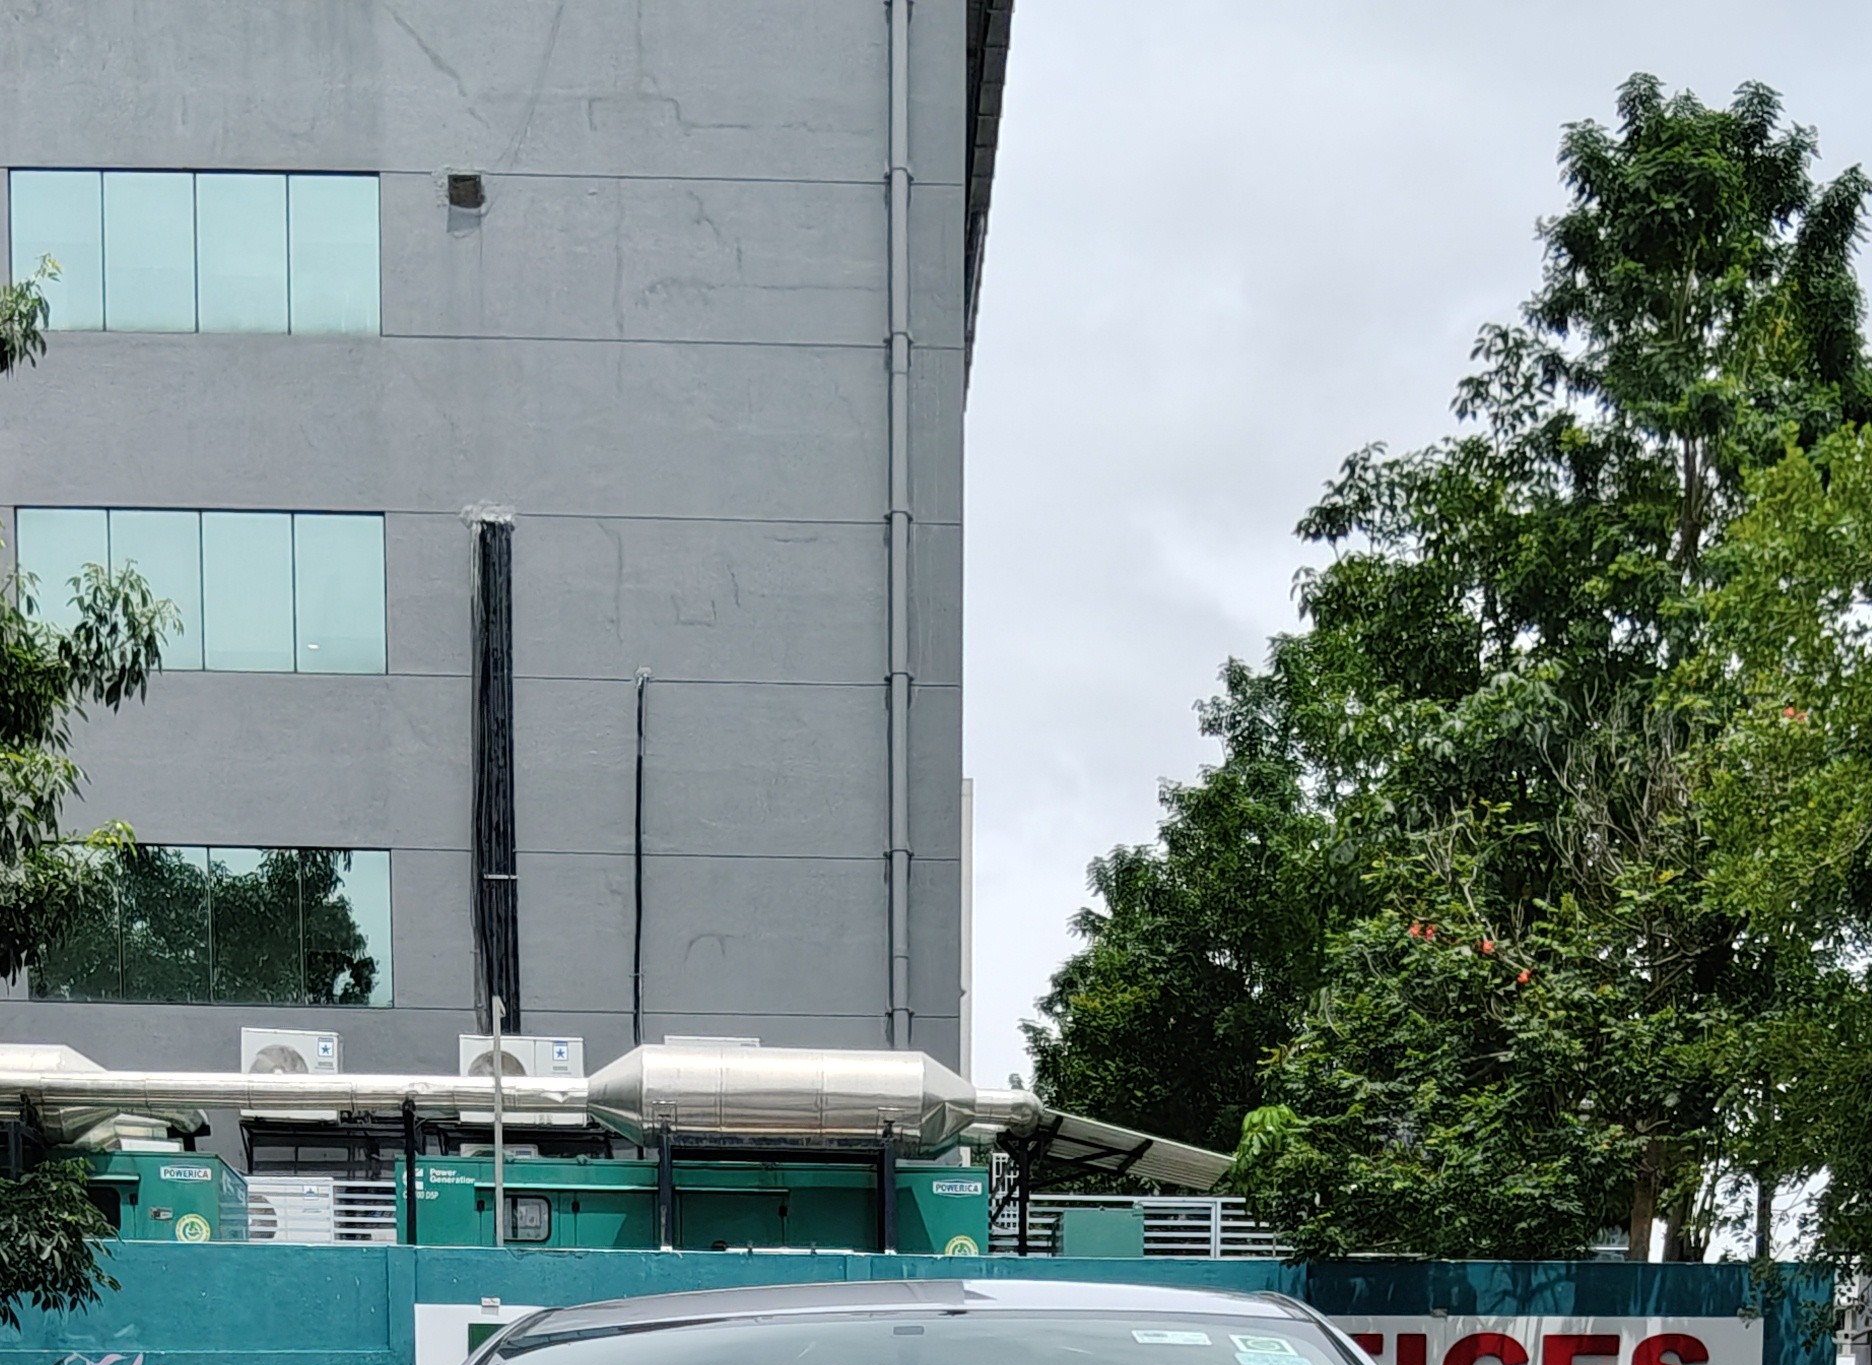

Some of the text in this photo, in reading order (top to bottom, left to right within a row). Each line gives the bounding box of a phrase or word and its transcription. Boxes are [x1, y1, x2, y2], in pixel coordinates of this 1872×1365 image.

[163, 1168, 209, 1179] POWERICA
[429, 1168, 457, 1176] Power
[429, 1176, 476, 1184] Generation
[935, 1183, 980, 1193] POWERICA
